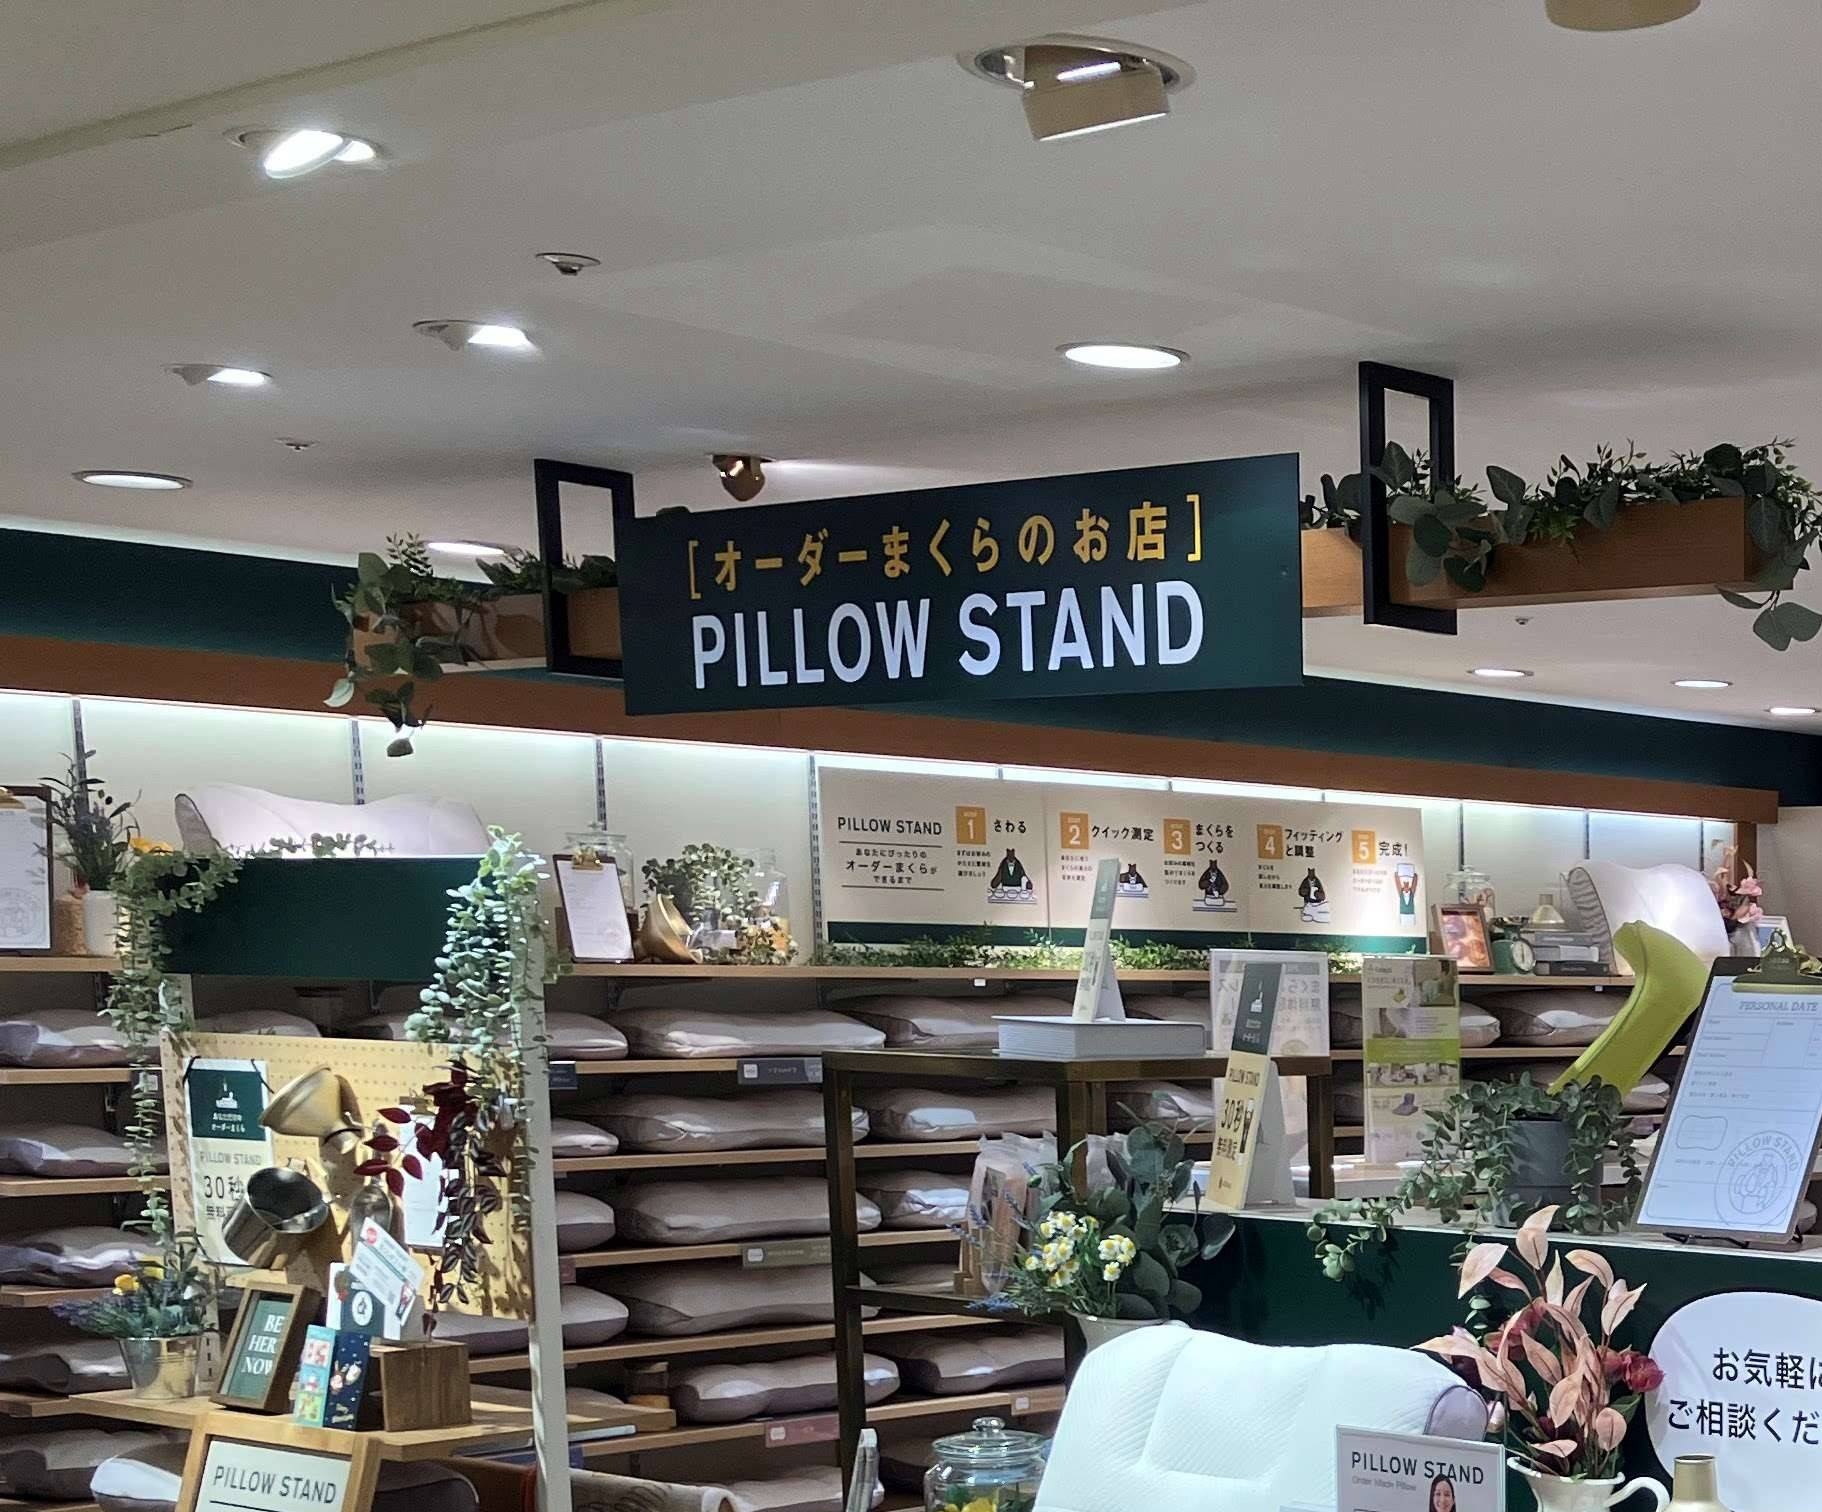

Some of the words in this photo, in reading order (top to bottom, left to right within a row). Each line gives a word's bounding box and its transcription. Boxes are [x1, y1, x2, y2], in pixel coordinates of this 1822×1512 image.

[693, 599, 929, 689] PILLOW
[958, 580, 1204, 676] STAND
[838, 816, 891, 833] PILLOW
[896, 819, 942, 835] STAND
[967, 819, 975, 839] 1
[994, 819, 1026, 833] さわる
[1069, 825, 1081, 845] 2
[1091, 824, 1154, 842] クイック測定
[1195, 823, 1234, 838] まくらを
[1171, 830, 1183, 850] 3
[1284, 828, 1343, 843] フィッティング
[1195, 840, 1224, 853] つくる
[1264, 836, 1275, 855] 4
[1358, 841, 1369, 860] 5
[265, 1314, 286, 1333] BE
[1351, 1451, 1417, 1476] PILLOW
[1424, 1461, 1484, 1485] STAND
[213, 1465, 276, 1494] PILLOW
[279, 1475, 336, 1504] STAND
